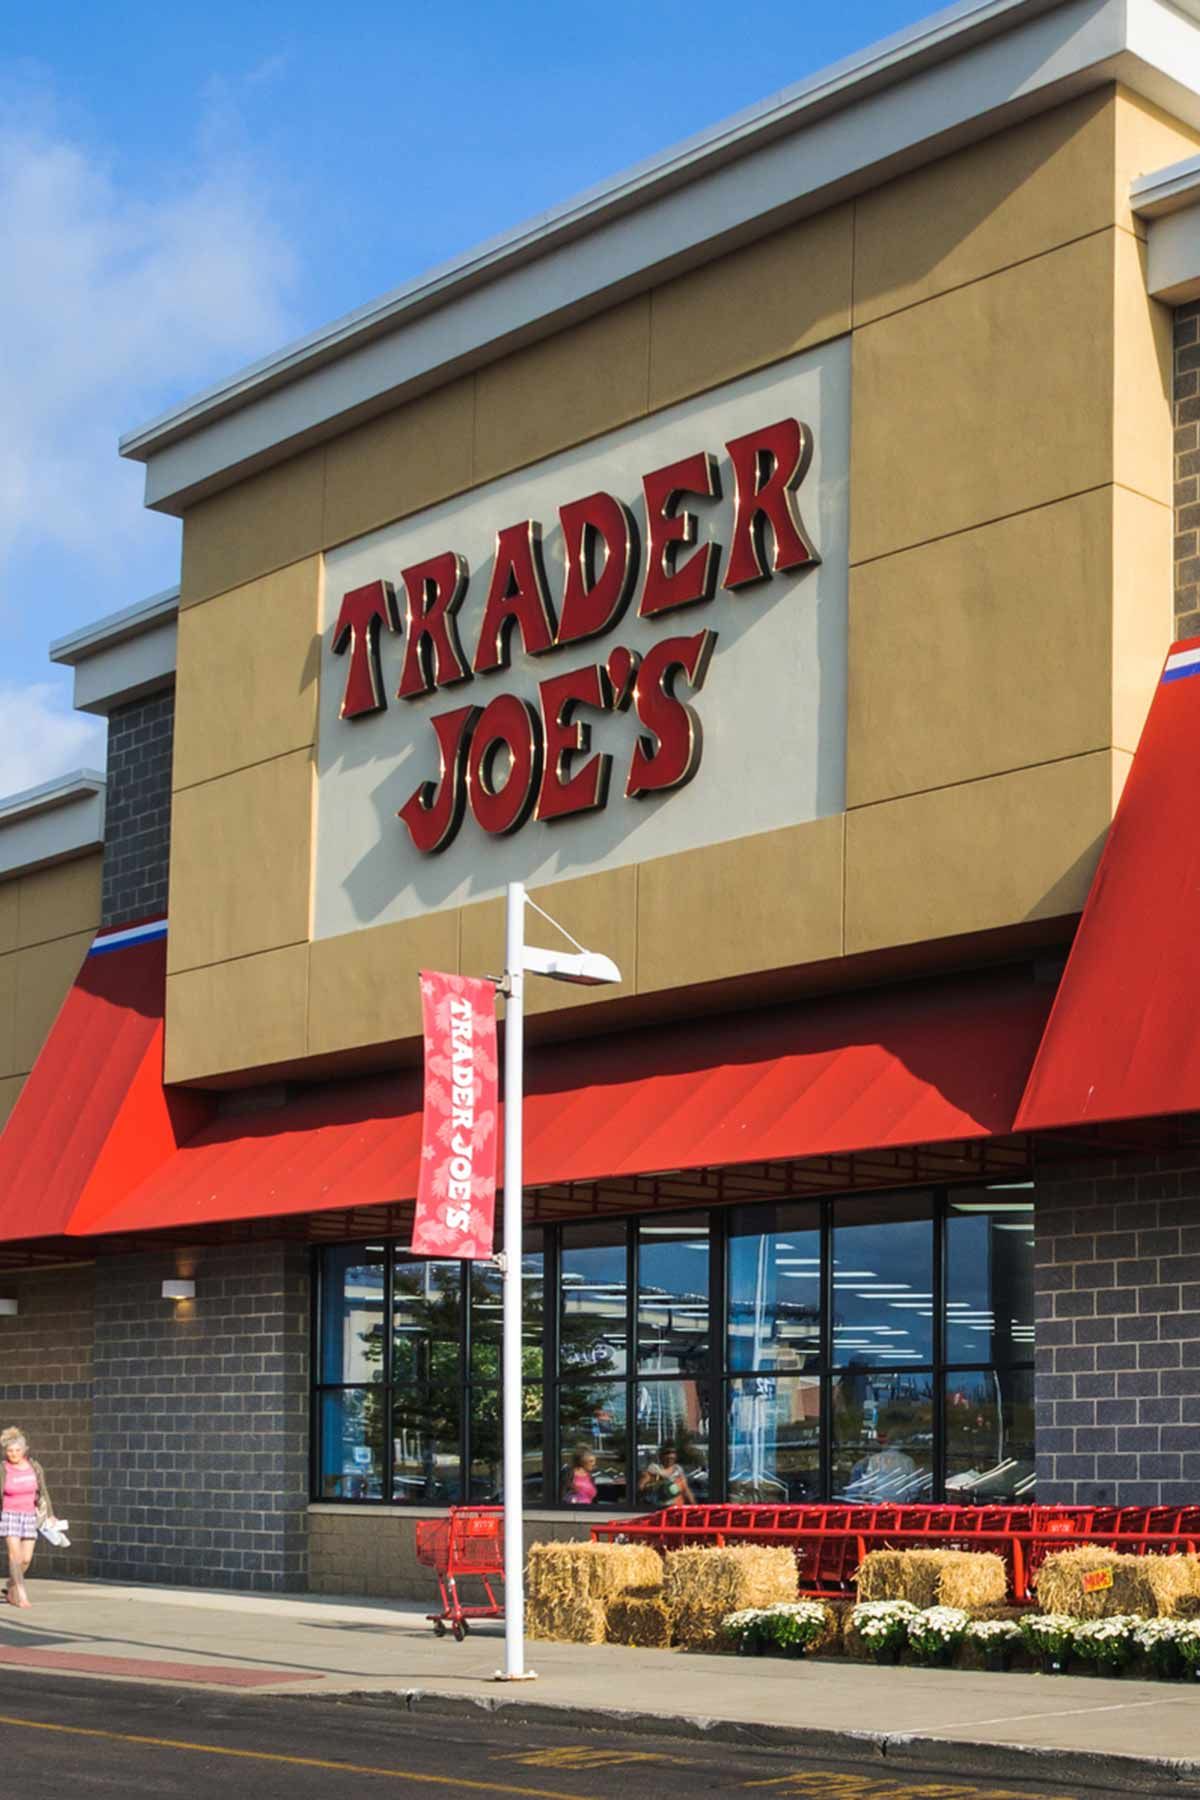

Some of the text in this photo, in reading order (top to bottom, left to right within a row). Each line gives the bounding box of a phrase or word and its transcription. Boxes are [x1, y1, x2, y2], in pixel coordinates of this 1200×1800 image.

[331, 417, 822, 720] TRADER
[396, 629, 719, 855] JOE'S
[446, 997, 475, 1233] TRADER JOE'S
